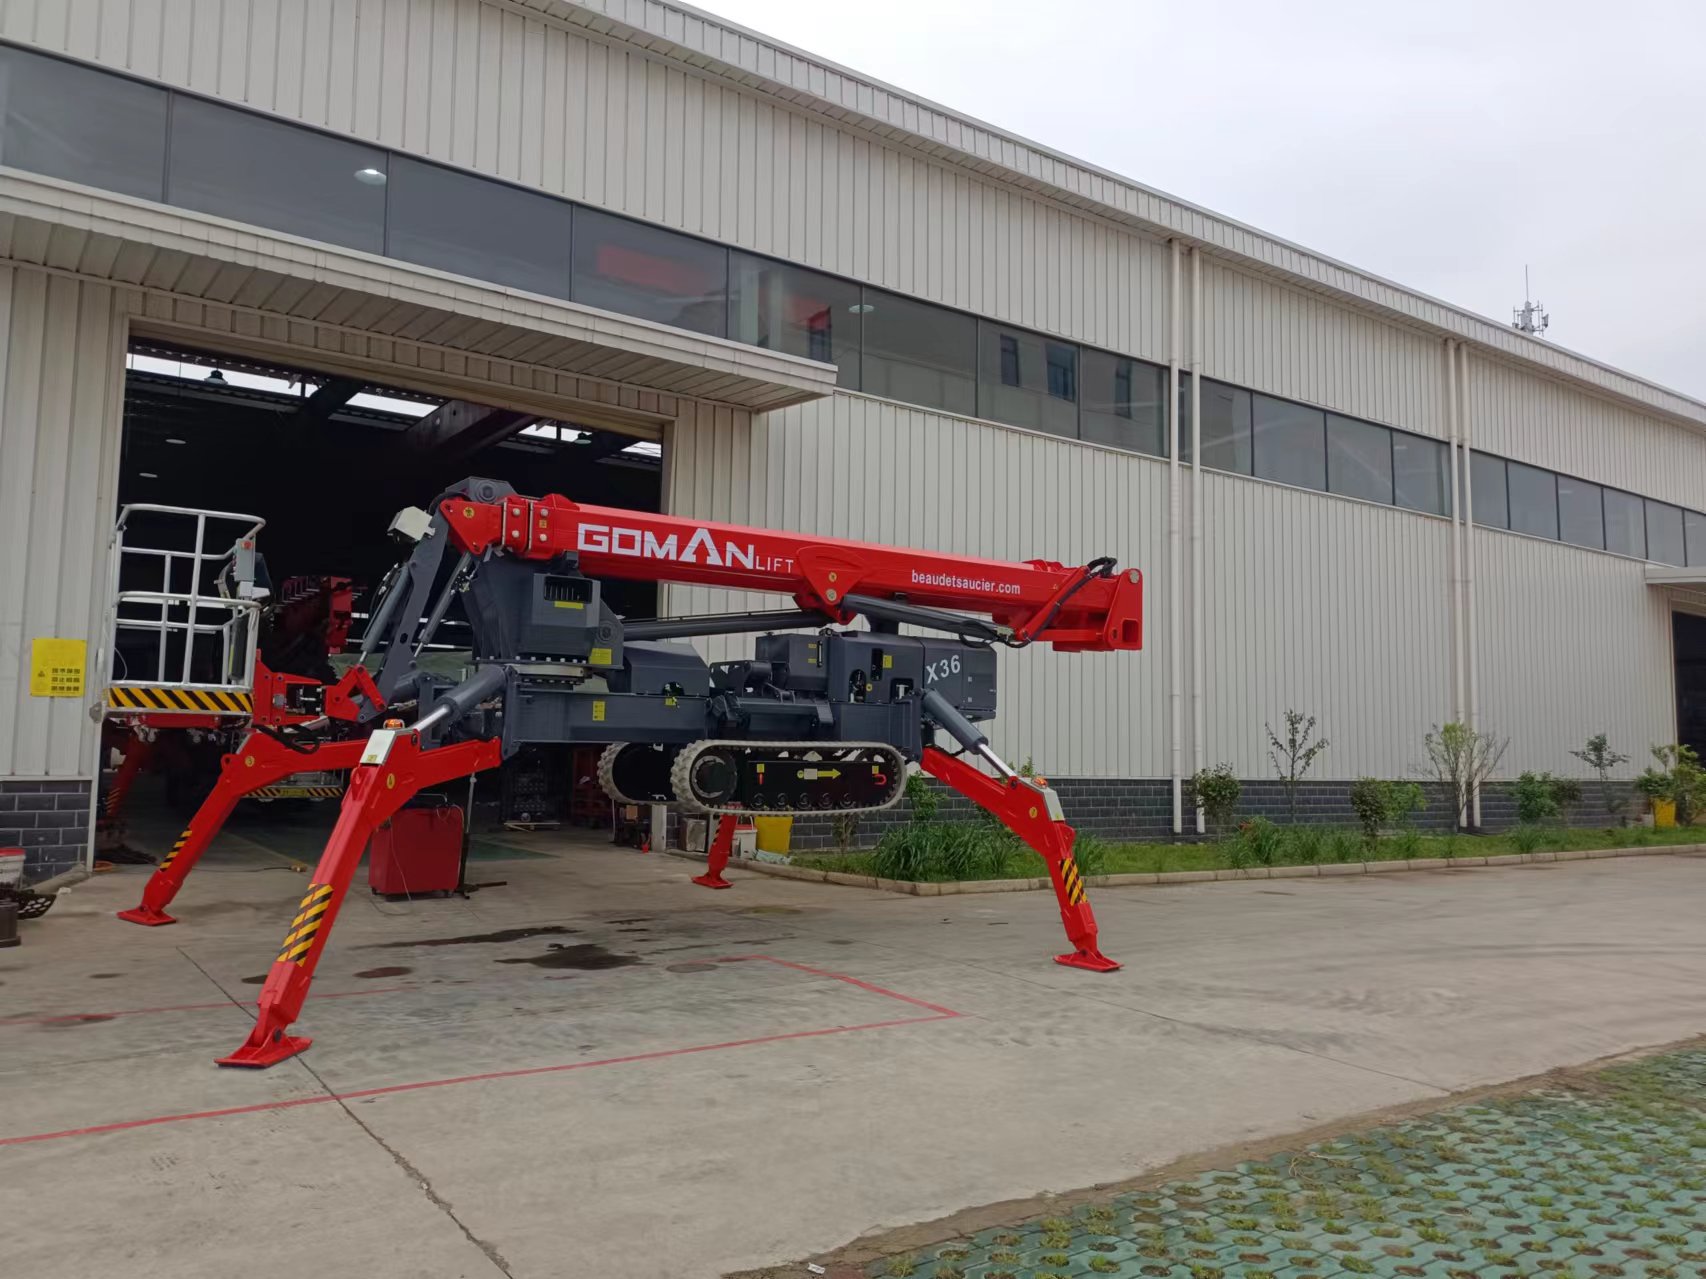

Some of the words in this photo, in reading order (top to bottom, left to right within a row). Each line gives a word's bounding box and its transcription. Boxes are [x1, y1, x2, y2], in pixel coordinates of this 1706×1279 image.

[756, 556, 794, 573] LIFT
[911, 569, 1021, 595] beaudetsaucier.com
[926, 654, 961, 685] X36
